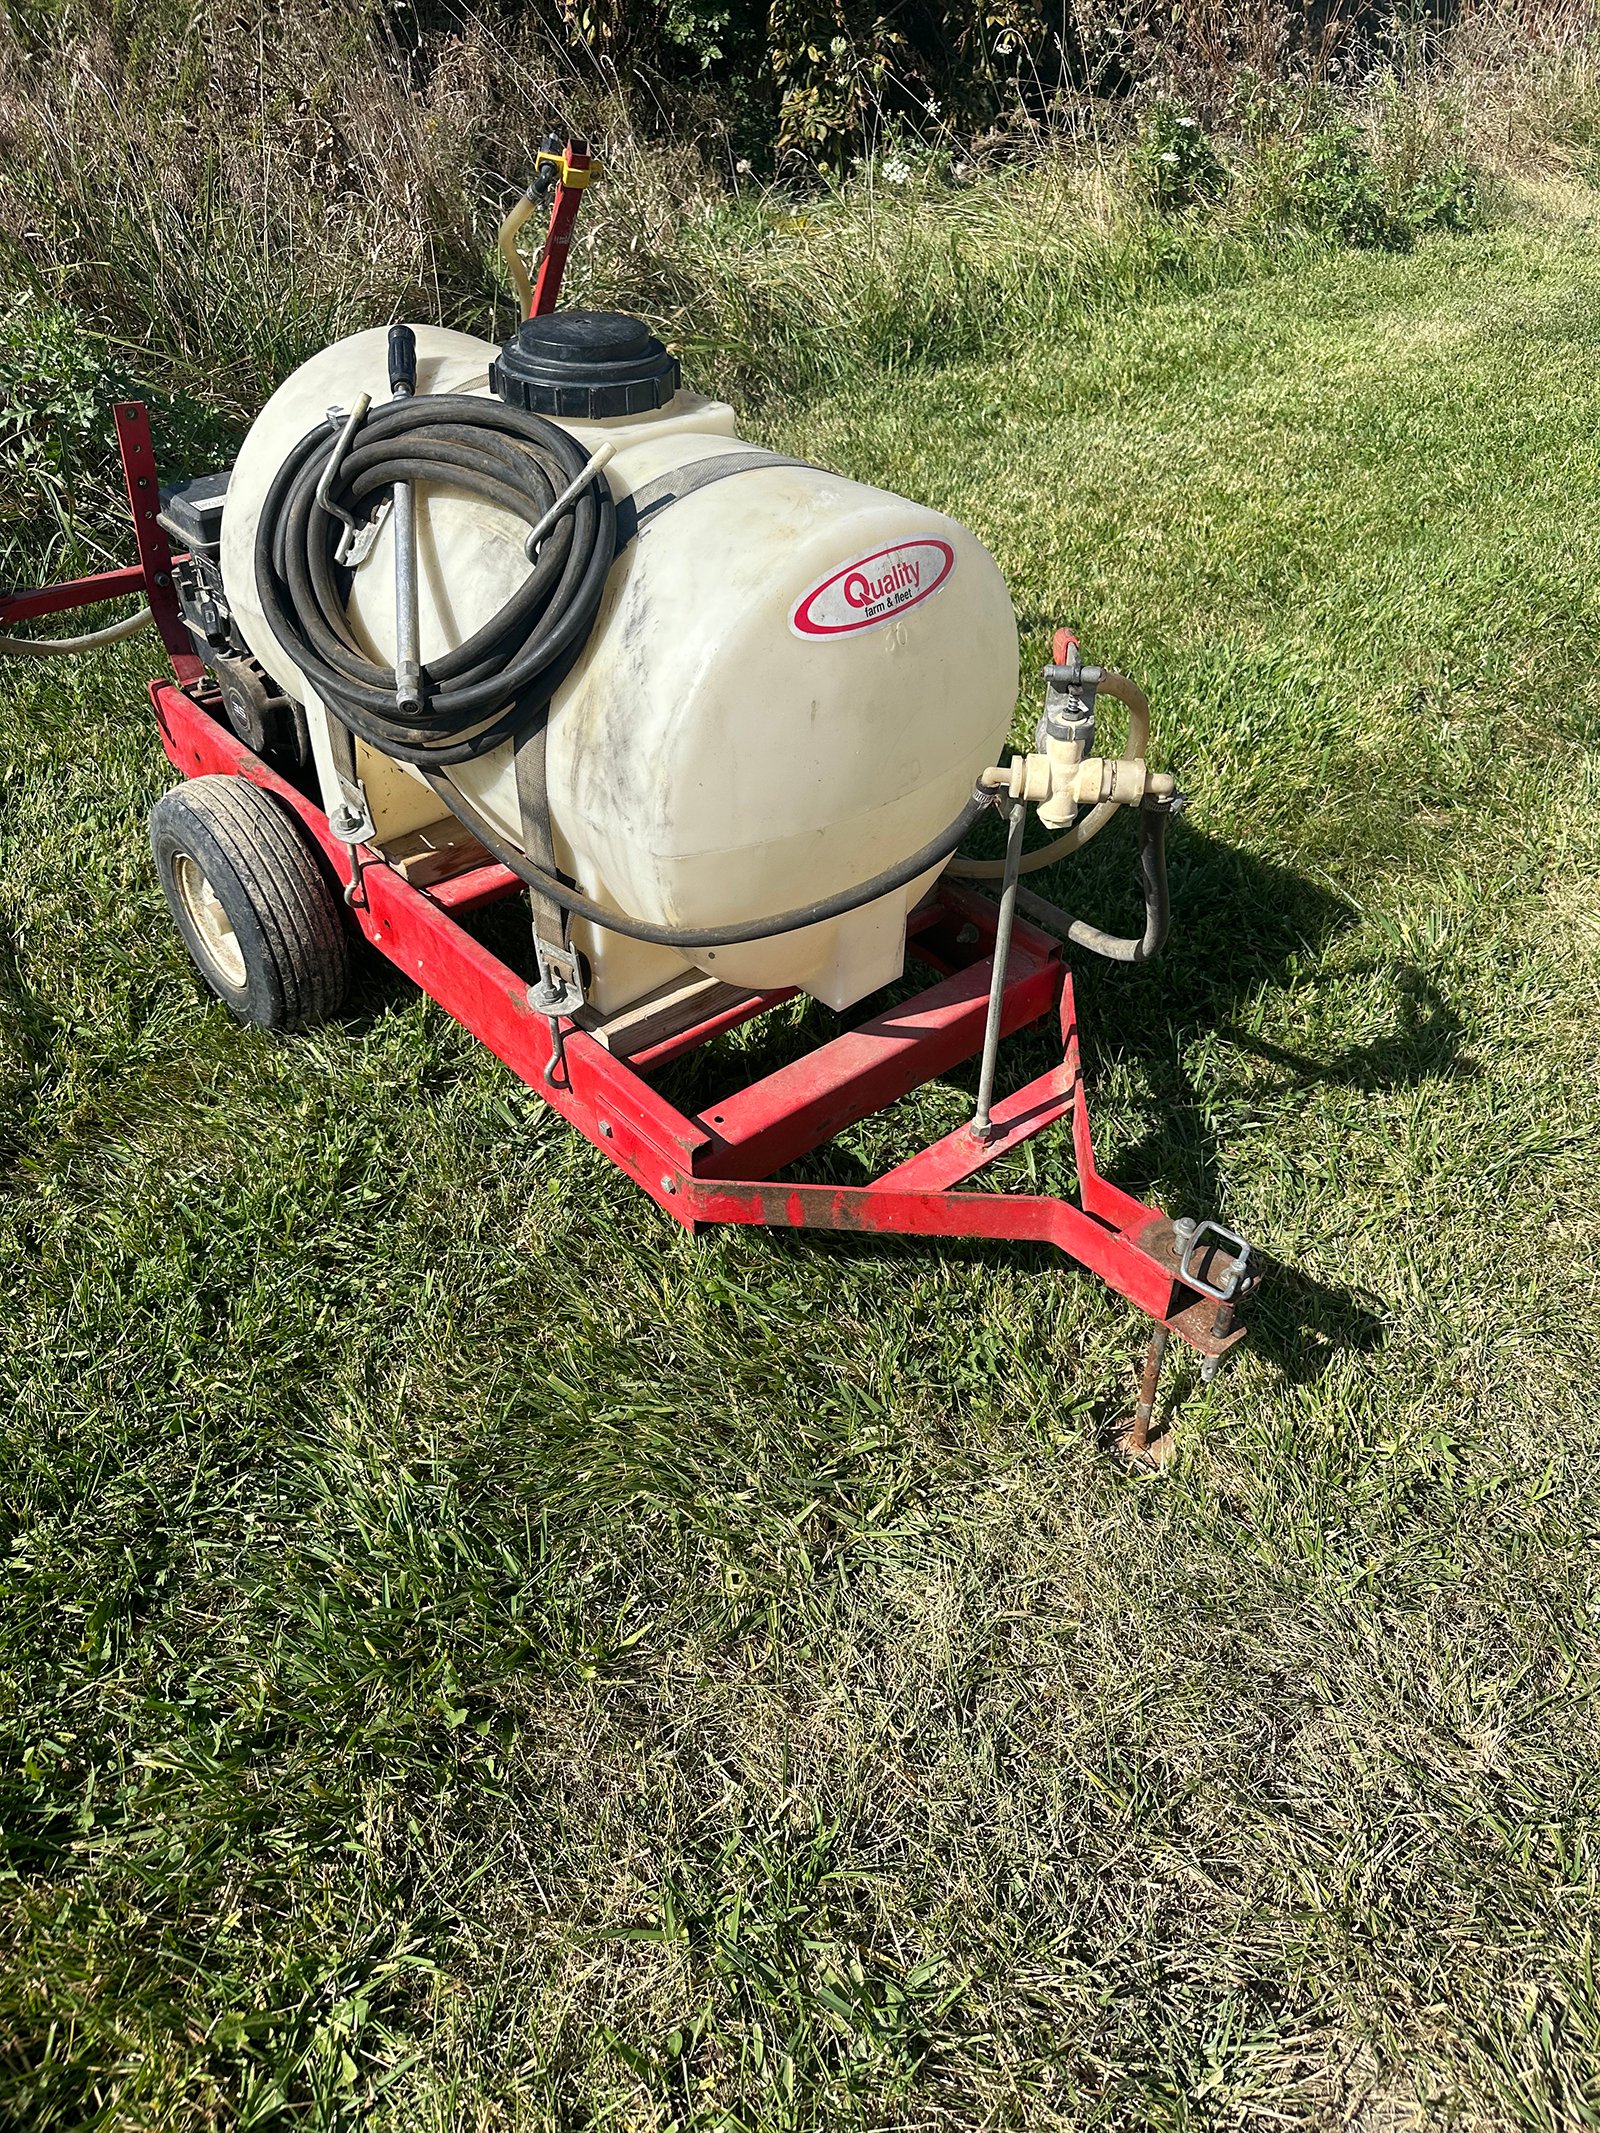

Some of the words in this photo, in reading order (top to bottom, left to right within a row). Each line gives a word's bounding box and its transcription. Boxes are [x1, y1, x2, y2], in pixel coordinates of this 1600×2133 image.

[844, 561, 919, 608] Quality
[865, 602, 885, 618] farm
[886, 597, 893, 608] &
[894, 588, 913, 604] fleet
